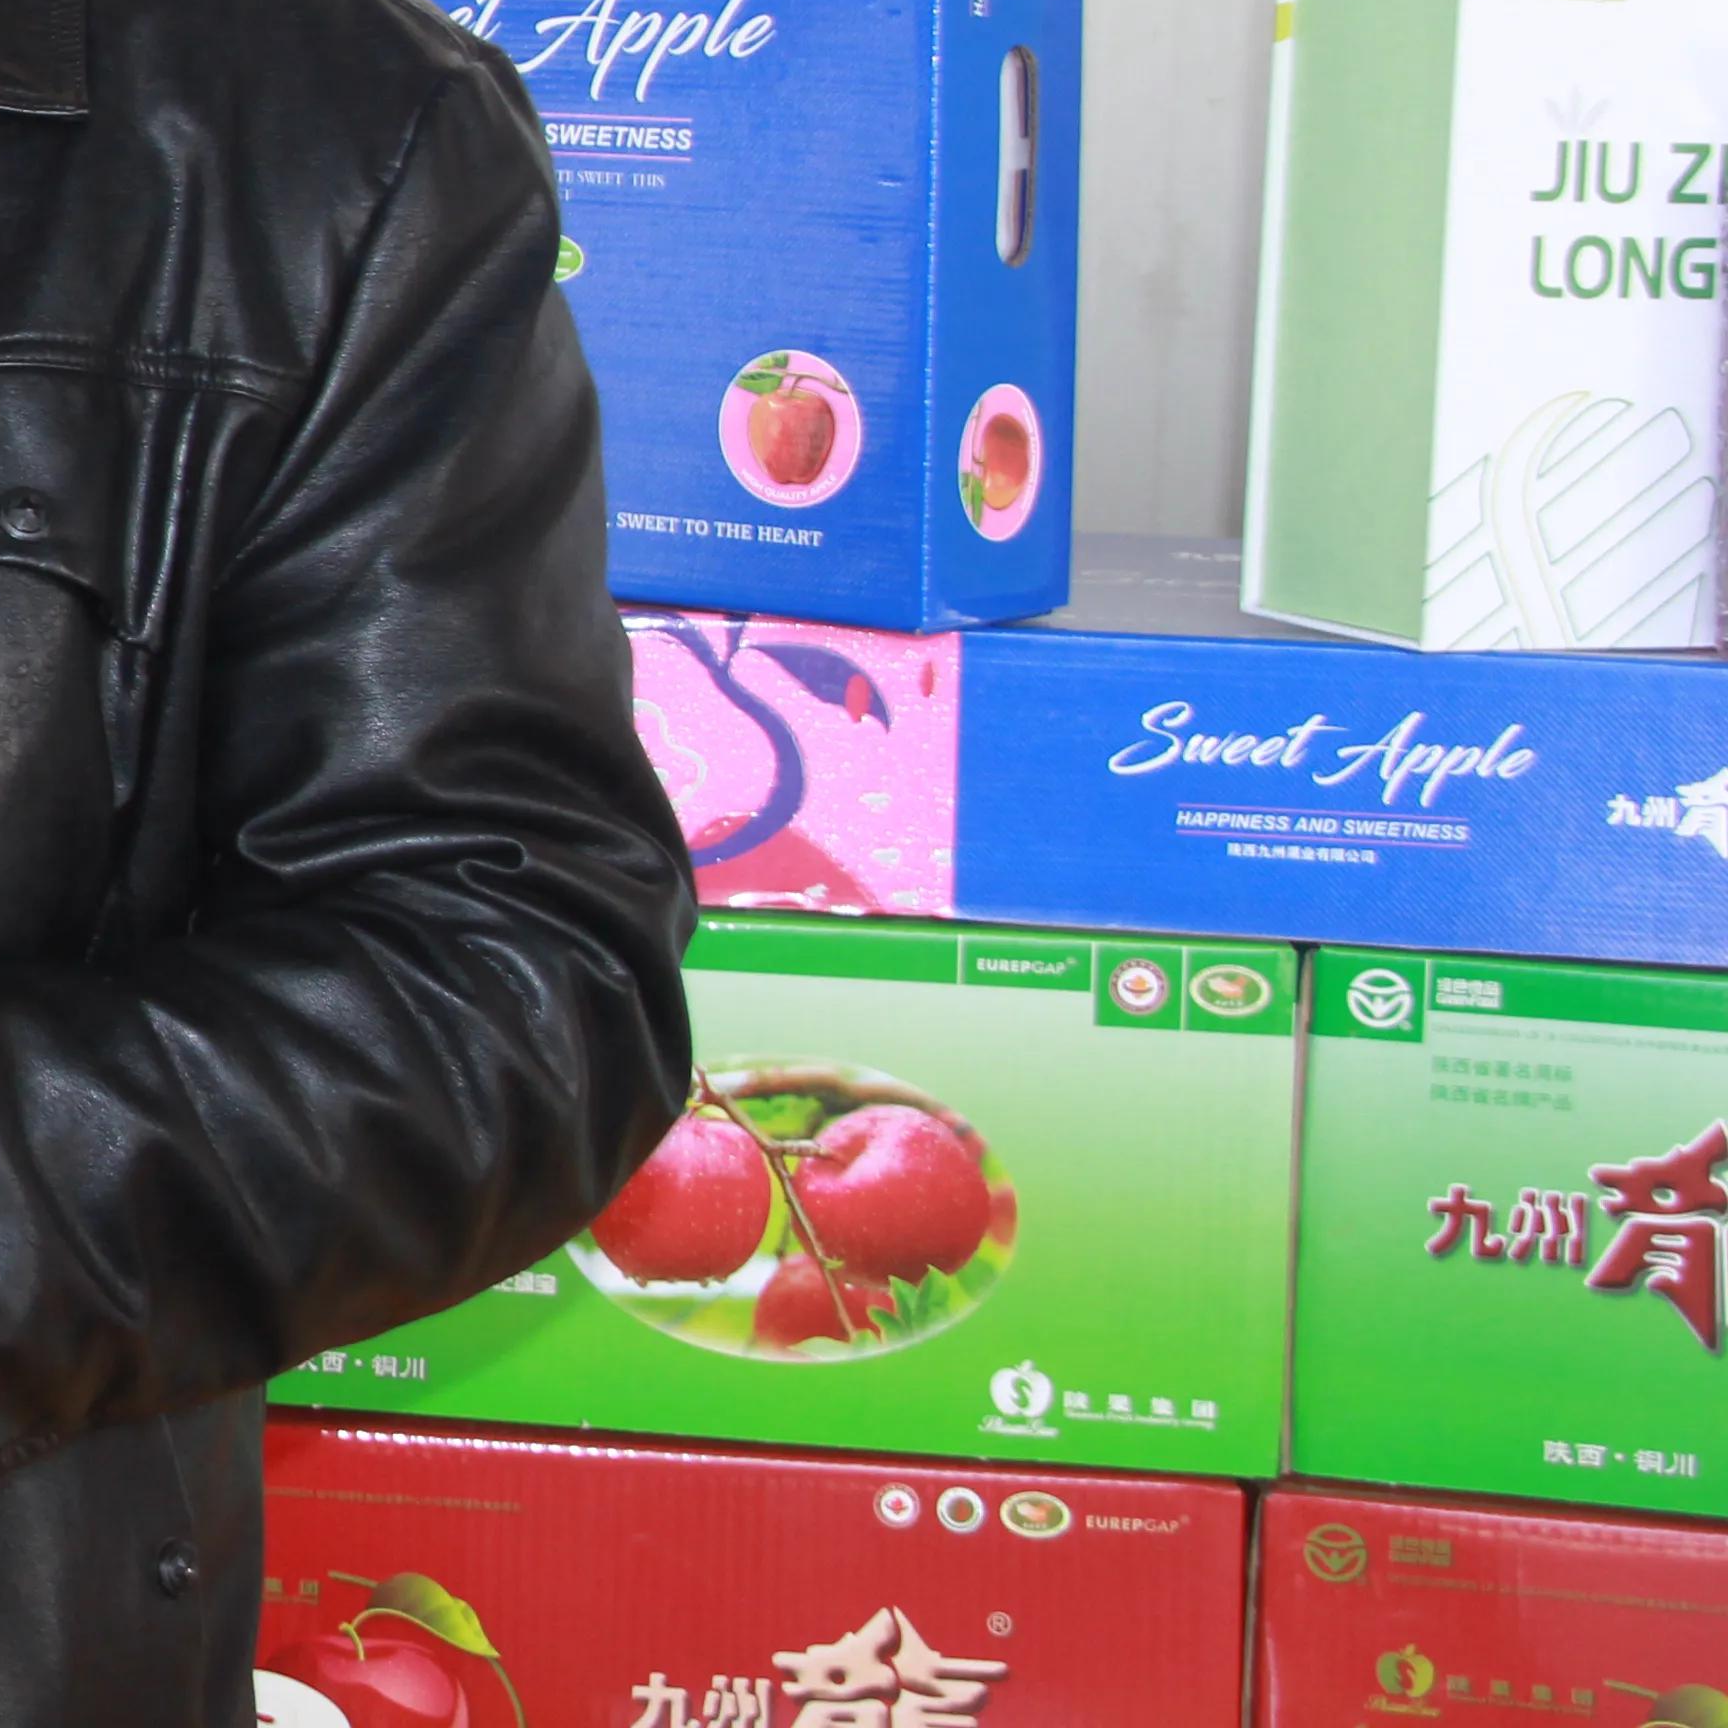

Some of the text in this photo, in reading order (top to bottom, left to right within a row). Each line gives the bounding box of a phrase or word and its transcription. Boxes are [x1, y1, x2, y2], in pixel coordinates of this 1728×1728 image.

[545, 123, 693, 151] SWEETNESS
[1530, 140, 1642, 204] JIU
[1530, 235, 1716, 300] LONG
[616, 511, 824, 548] SWEET TO THE HEART
[1108, 701, 1538, 808] Sweet Apple
[1176, 809, 1469, 842] HAPPINESS AND SWEETNESS
[976, 956, 1066, 976] EUREPGAP
[1085, 1515, 1179, 1534] EUREPGAP
